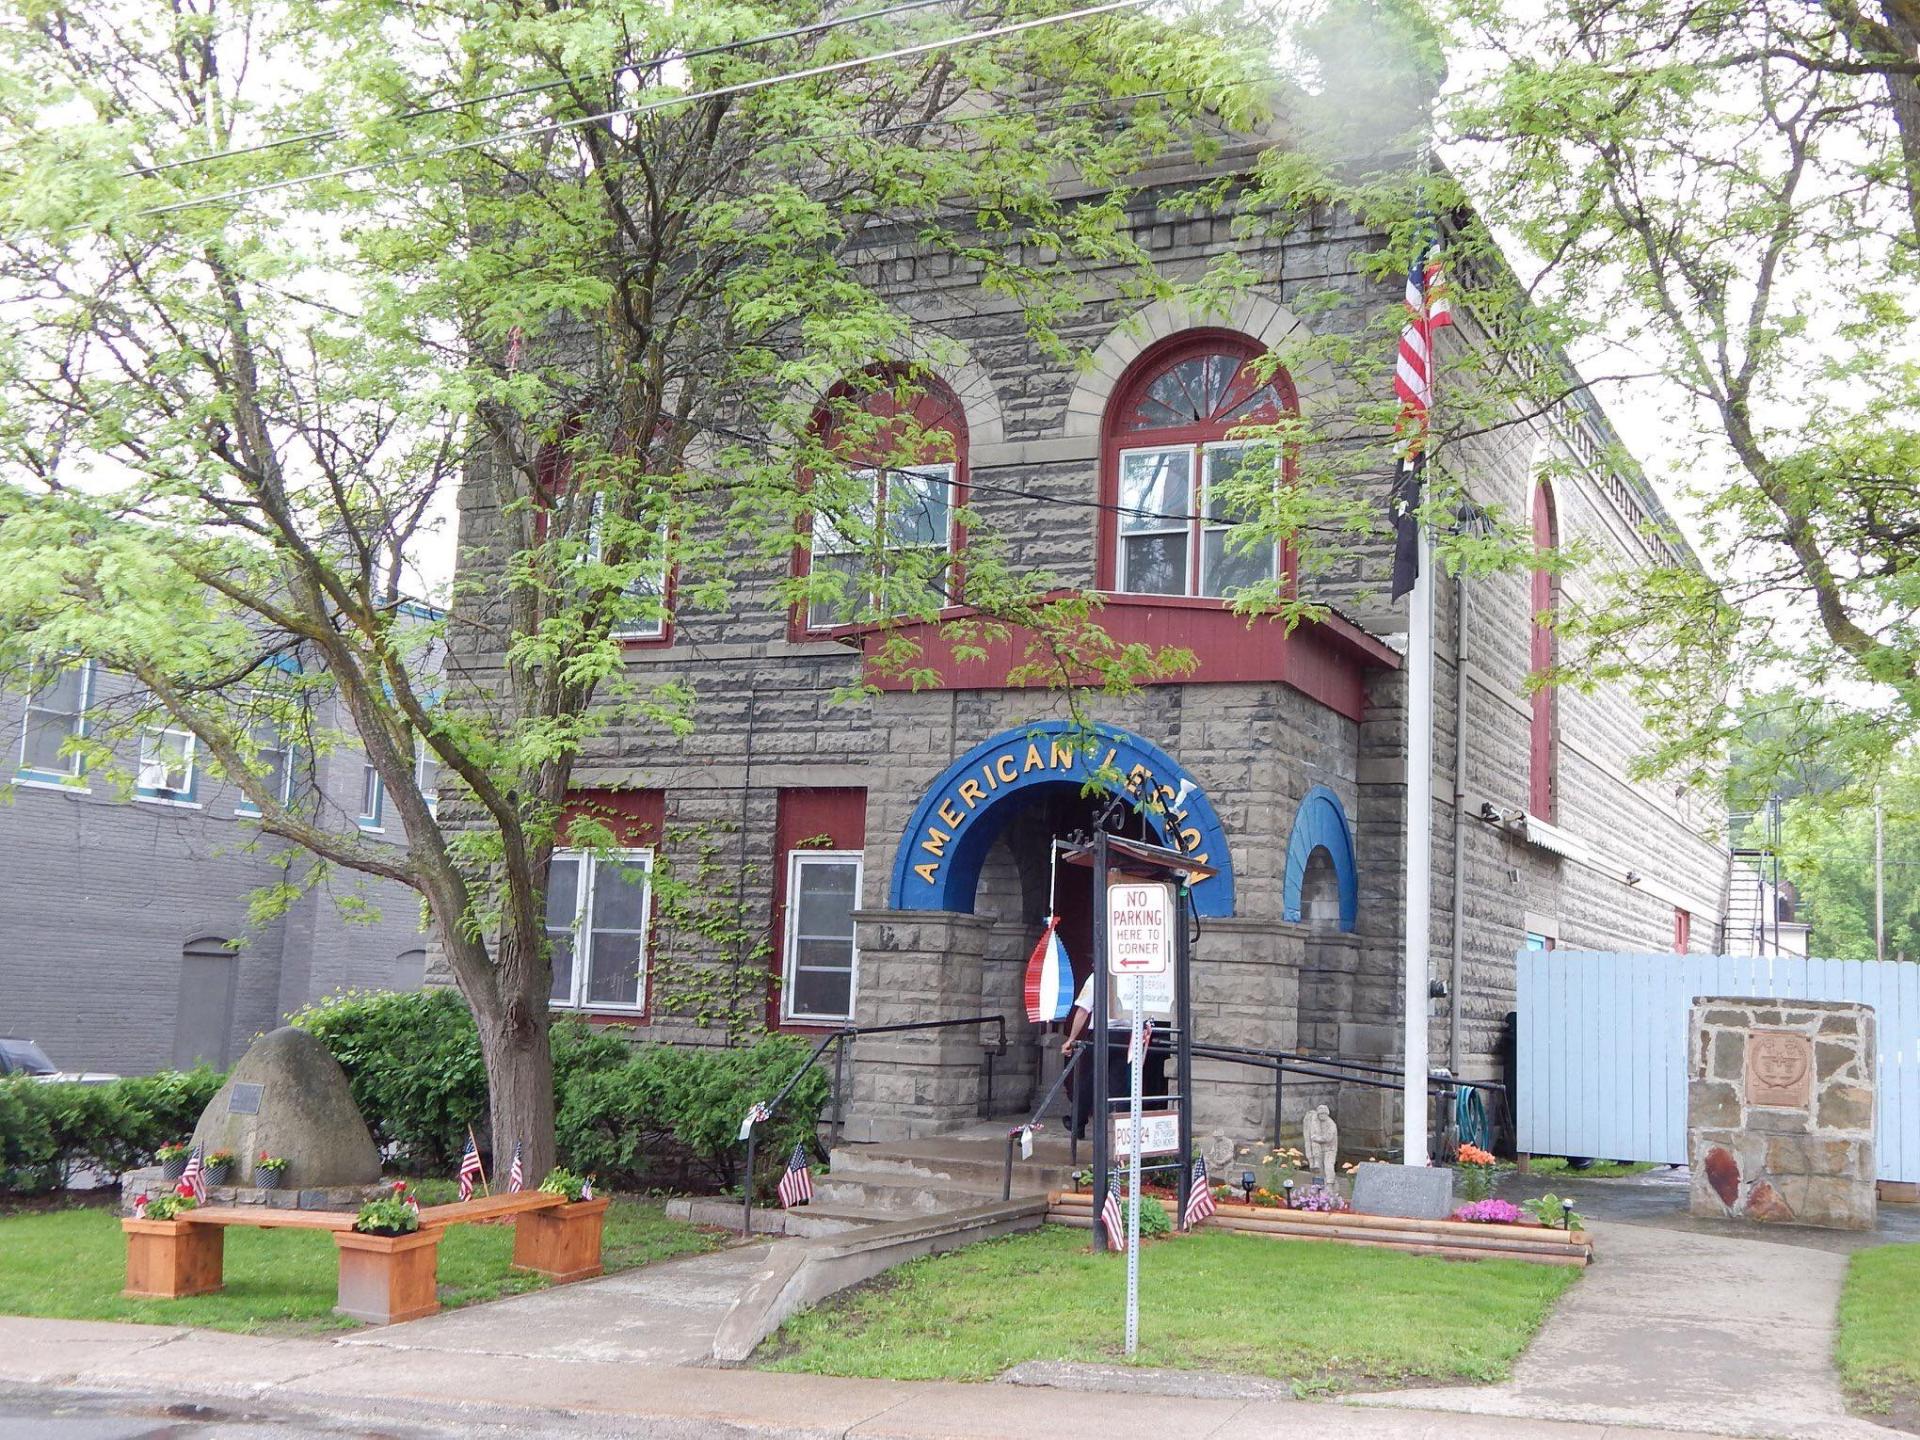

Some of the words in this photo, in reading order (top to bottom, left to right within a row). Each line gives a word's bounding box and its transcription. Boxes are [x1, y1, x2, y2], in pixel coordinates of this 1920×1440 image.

[914, 741, 1075, 885] AMERICAN
[1127, 891, 1147, 907] NO
[1113, 910, 1162, 926] PARKING
[1117, 929, 1142, 940] HERE
[1148, 929, 1160, 940] TO
[1118, 943, 1159, 954] CORNER
[1117, 1127, 1132, 1146] POS
